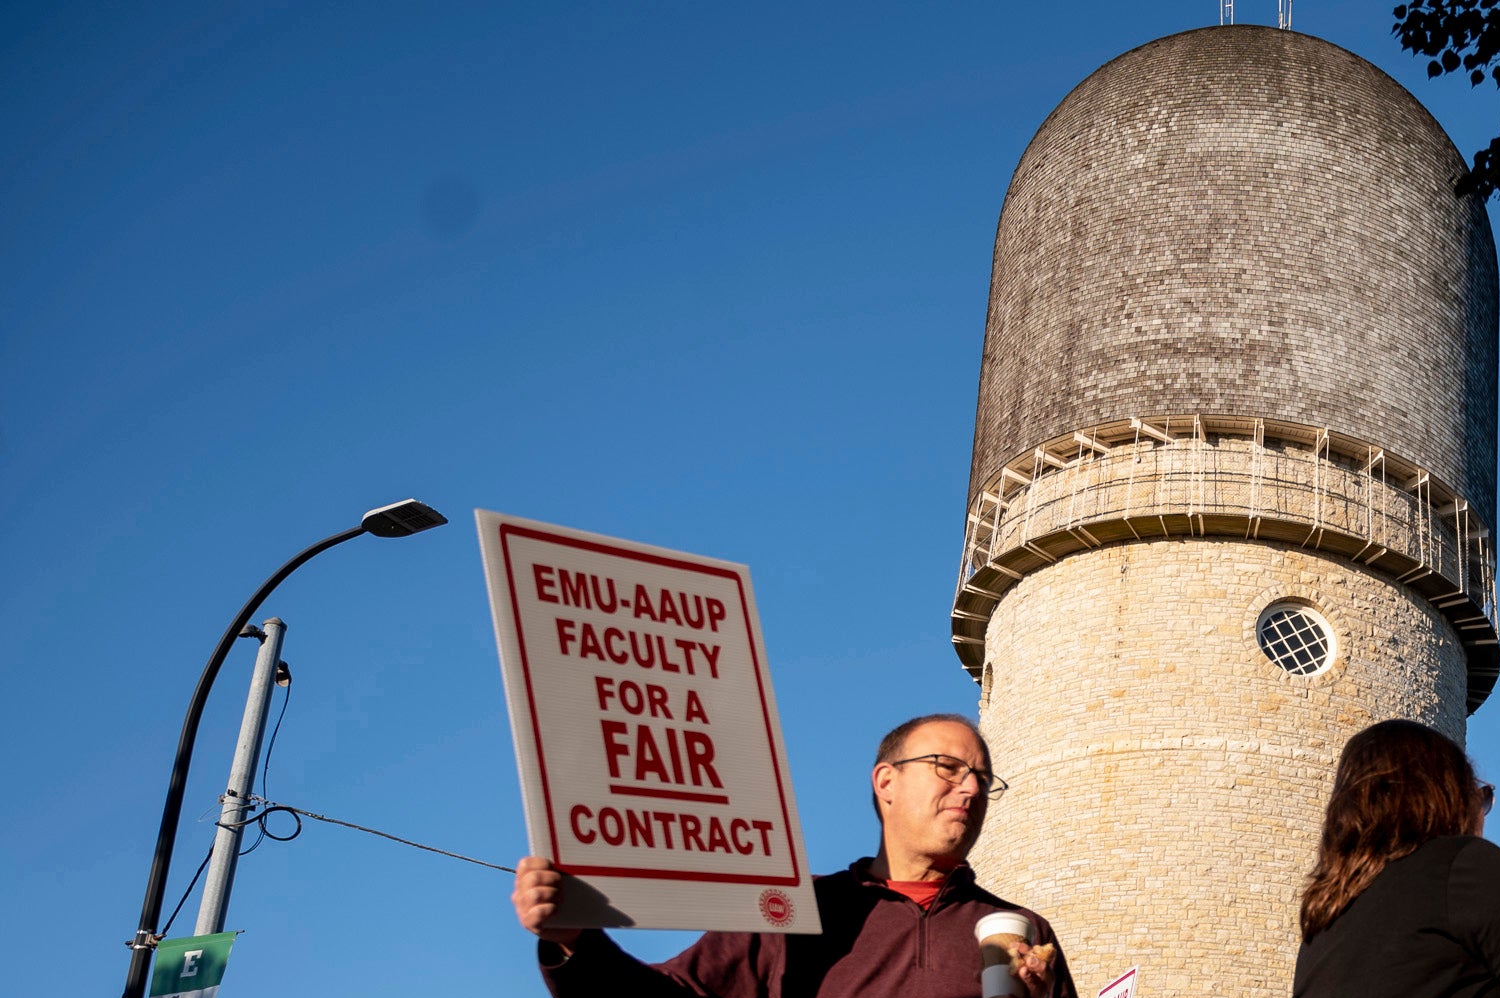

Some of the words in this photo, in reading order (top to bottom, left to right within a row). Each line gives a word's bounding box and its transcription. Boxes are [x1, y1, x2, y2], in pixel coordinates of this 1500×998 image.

[532, 563, 728, 633] EMU-AAUP
[555, 617, 722, 679] FACULTY
[595, 676, 673, 720] FOR
[685, 691, 711, 725] A
[601, 719, 725, 789] FAIR
[570, 803, 774, 857] CONTRACT
[180, 949, 203, 978] E
